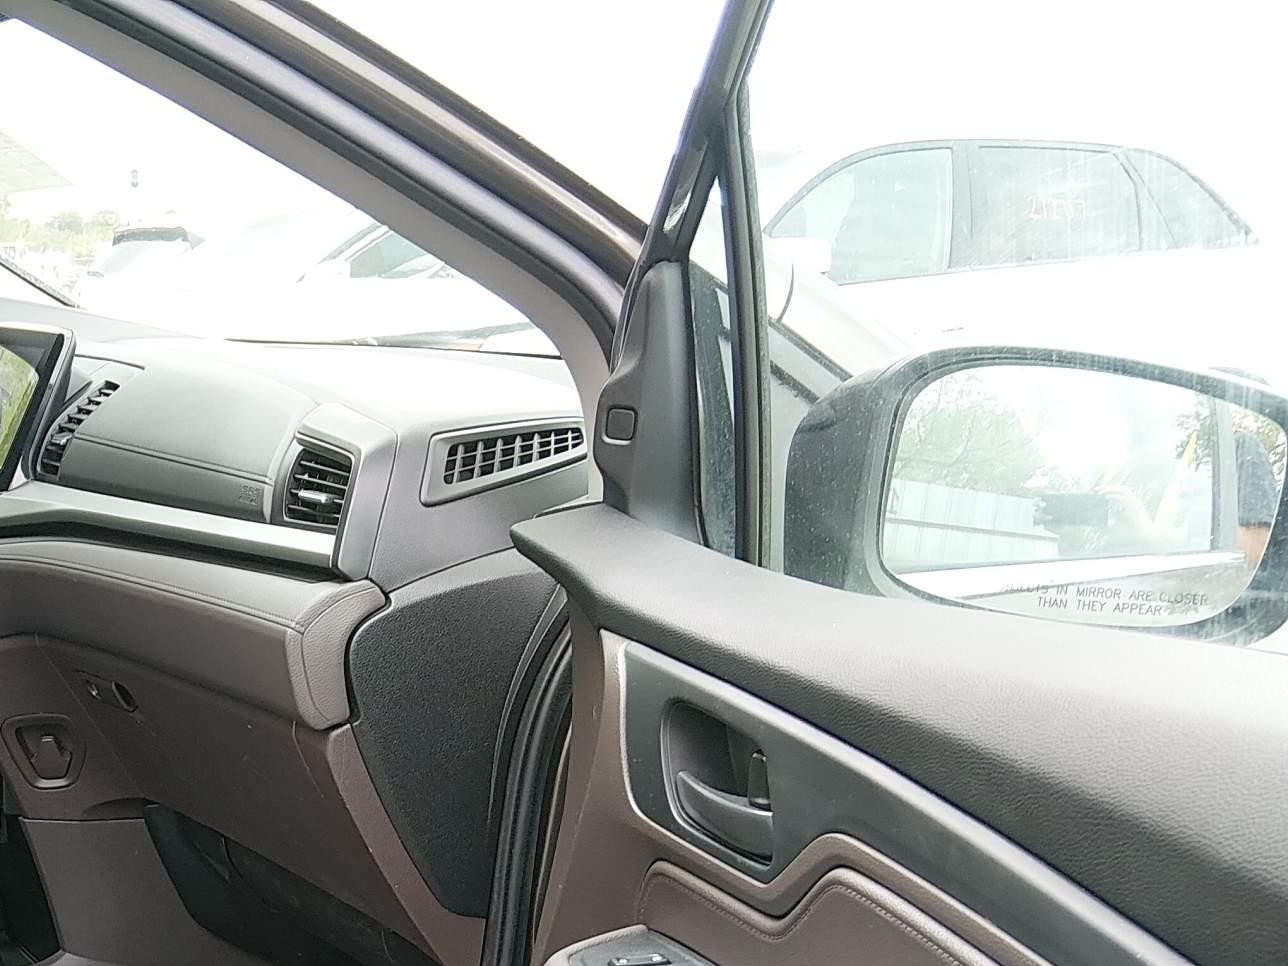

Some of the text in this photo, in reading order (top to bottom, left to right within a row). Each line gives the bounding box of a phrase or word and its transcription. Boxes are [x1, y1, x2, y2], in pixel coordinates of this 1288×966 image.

[1056, 584, 1069, 596] IN
[1076, 586, 1122, 600] MIRROR
[1128, 590, 1153, 601] ARE
[1159, 591, 1210, 606] CLOSER
[1038, 596, 1162, 616] THAN THEY APPEAR
